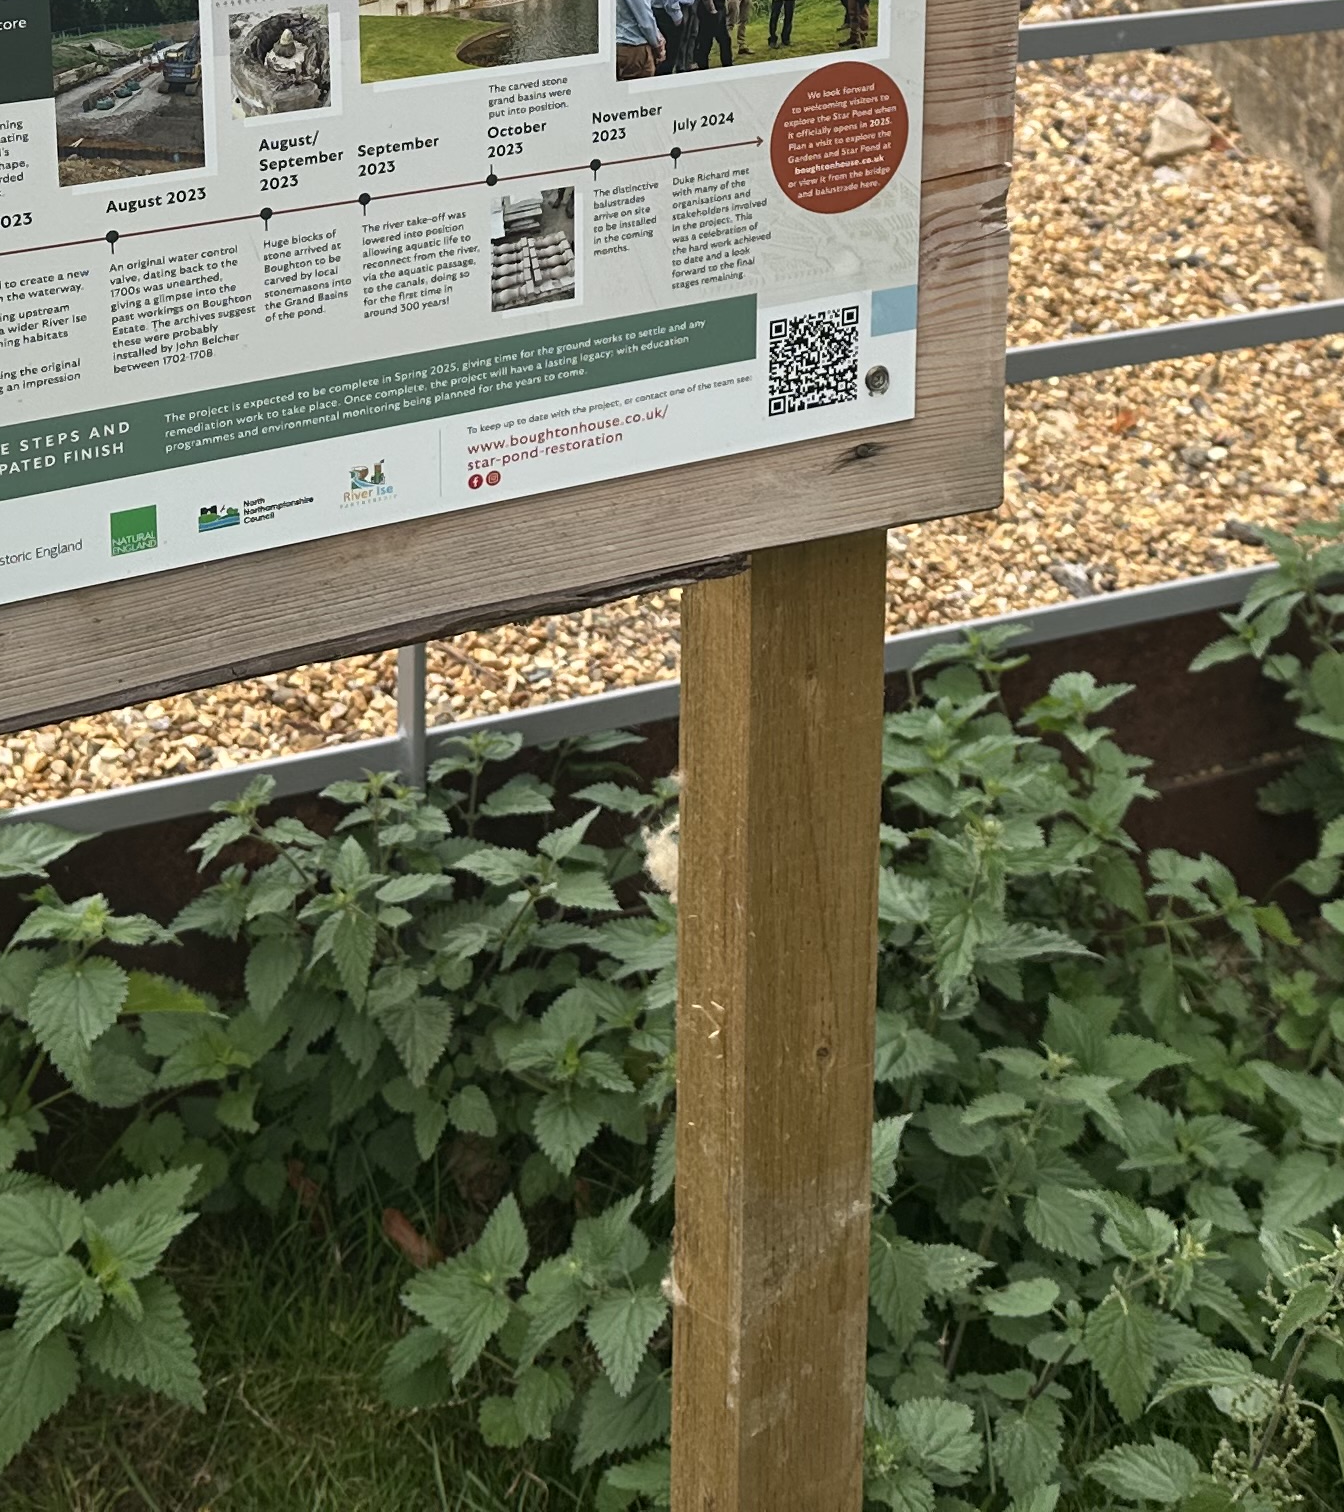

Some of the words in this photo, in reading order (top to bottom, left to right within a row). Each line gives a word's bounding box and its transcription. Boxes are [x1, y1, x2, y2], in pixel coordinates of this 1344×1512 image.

[488, 83, 507, 94] The
[508, 78, 540, 91] carved
[541, 76, 568, 87] stone
[487, 93, 516, 108] grand
[516, 91, 547, 102] basins
[548, 88, 572, 98] were
[487, 109, 506, 120] put
[507, 106, 527, 116] into
[592, 105, 662, 125] November
[672, 117, 697, 135] July
[700, 111, 735, 128] 2024
[487, 121, 547, 139] October
[591, 126, 626, 144] 2023
[258, 129, 320, 152] August/
[357, 136, 440, 158] September
[486, 141, 523, 159] 2023
[258, 150, 344, 172] September
[357, 159, 396, 177] 2023
[259, 173, 299, 192] 2023
[672, 175, 695, 186] Duke
[696, 169, 730, 182] Richard
[731, 167, 750, 176] met
[592, 188, 611, 198] The
[611, 181, 659, 195] distinctive
[105, 195, 163, 214] August
[165, 186, 207, 205] 2023
[3, 280, 17, 289] to
[19, 274, 55, 287] create
[57, 273, 64, 281] a
[66, 269, 90, 279] new
[19, 429, 80, 452] STEPS
[88, 421, 130, 440] AND
[466, 403, 669, 455] www.boughtonhouse.co.uk/
[63, 441, 124, 464] FINISH
[467, 432, 623, 471] star-pond-restoration
[35, 537, 83, 559] England
[112, 531, 156, 546] NATURAL
[112, 539, 157, 555] ENGLAND
